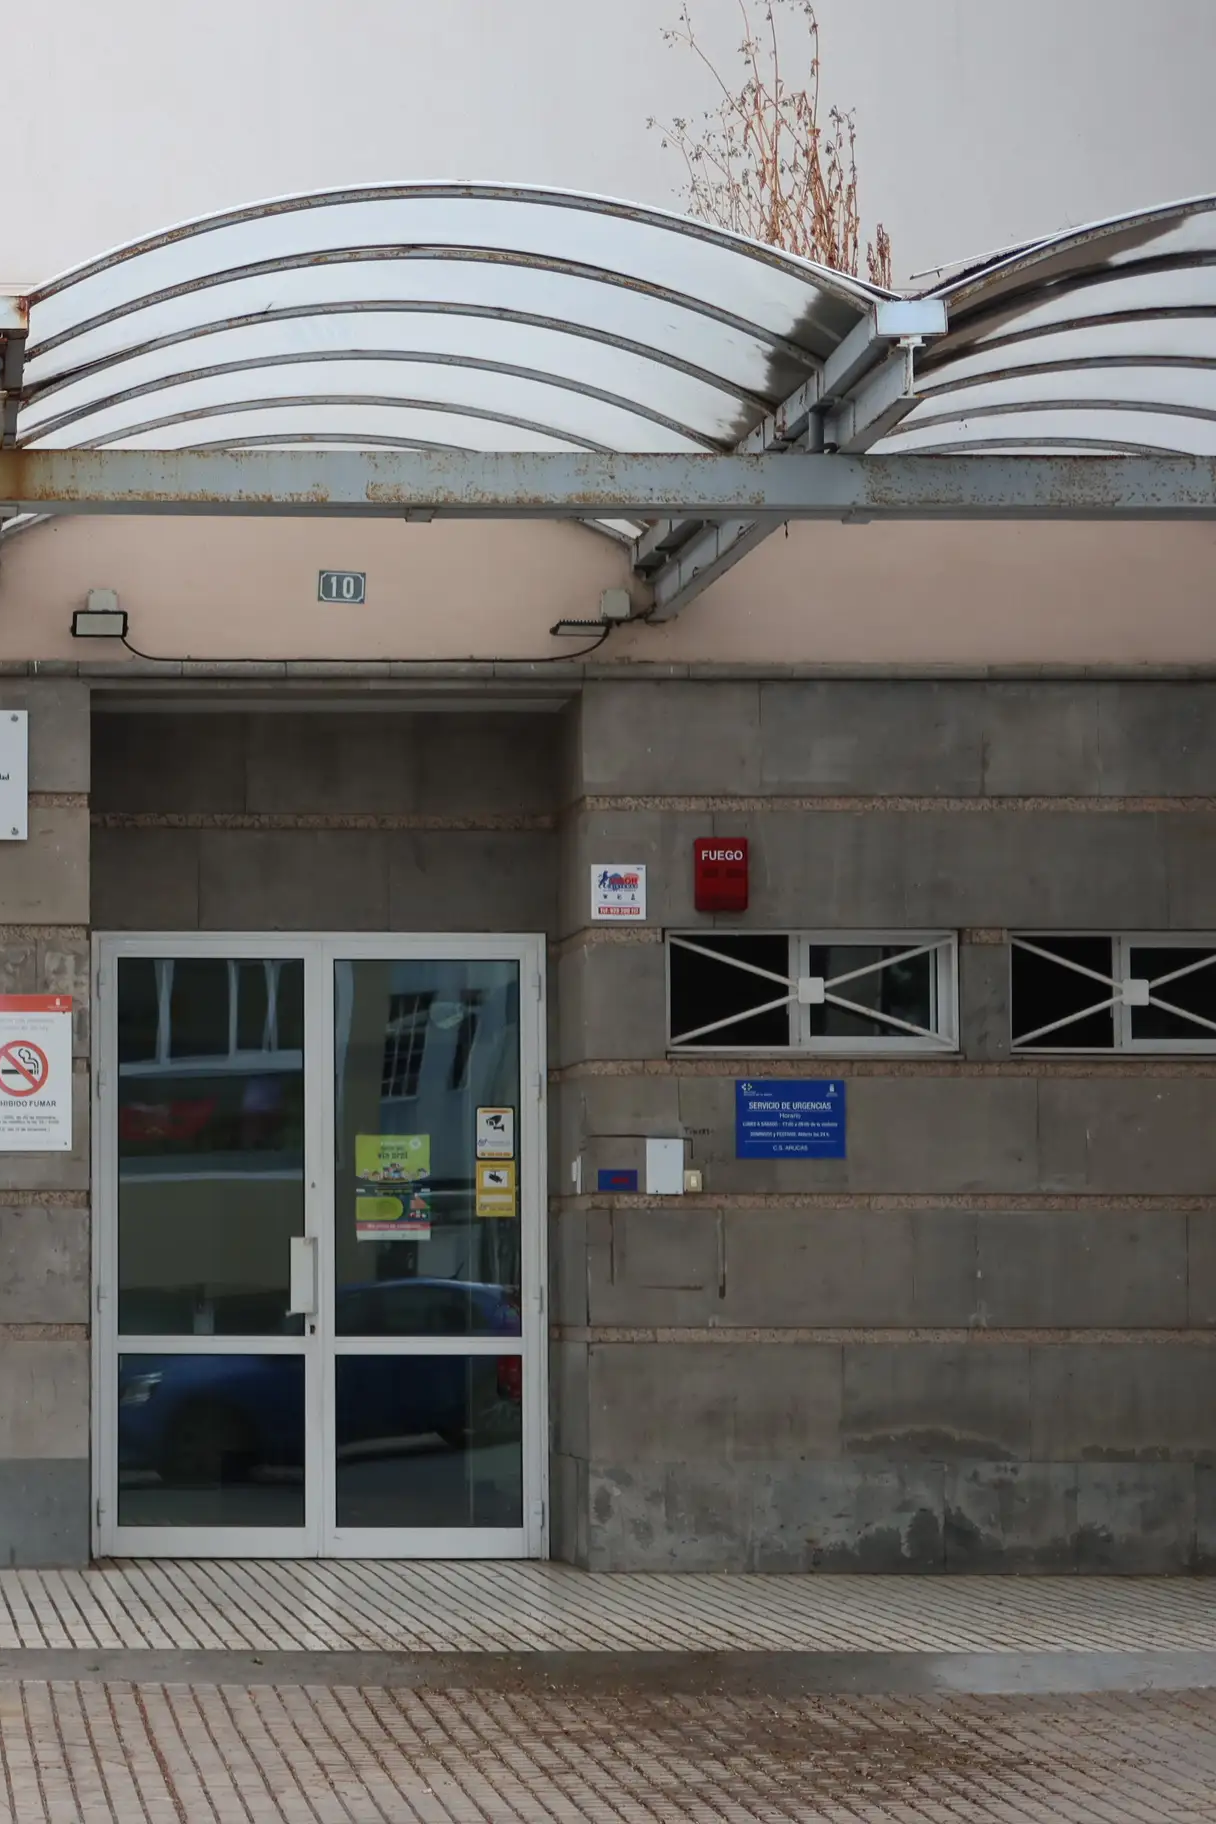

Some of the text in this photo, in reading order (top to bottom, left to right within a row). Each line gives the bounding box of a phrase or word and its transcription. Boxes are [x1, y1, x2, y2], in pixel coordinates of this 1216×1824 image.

[330, 575, 354, 598] 10
[701, 850, 743, 861] FUEGO
[748, 1101, 832, 1110] SERVICIO DE URGENCIAS
